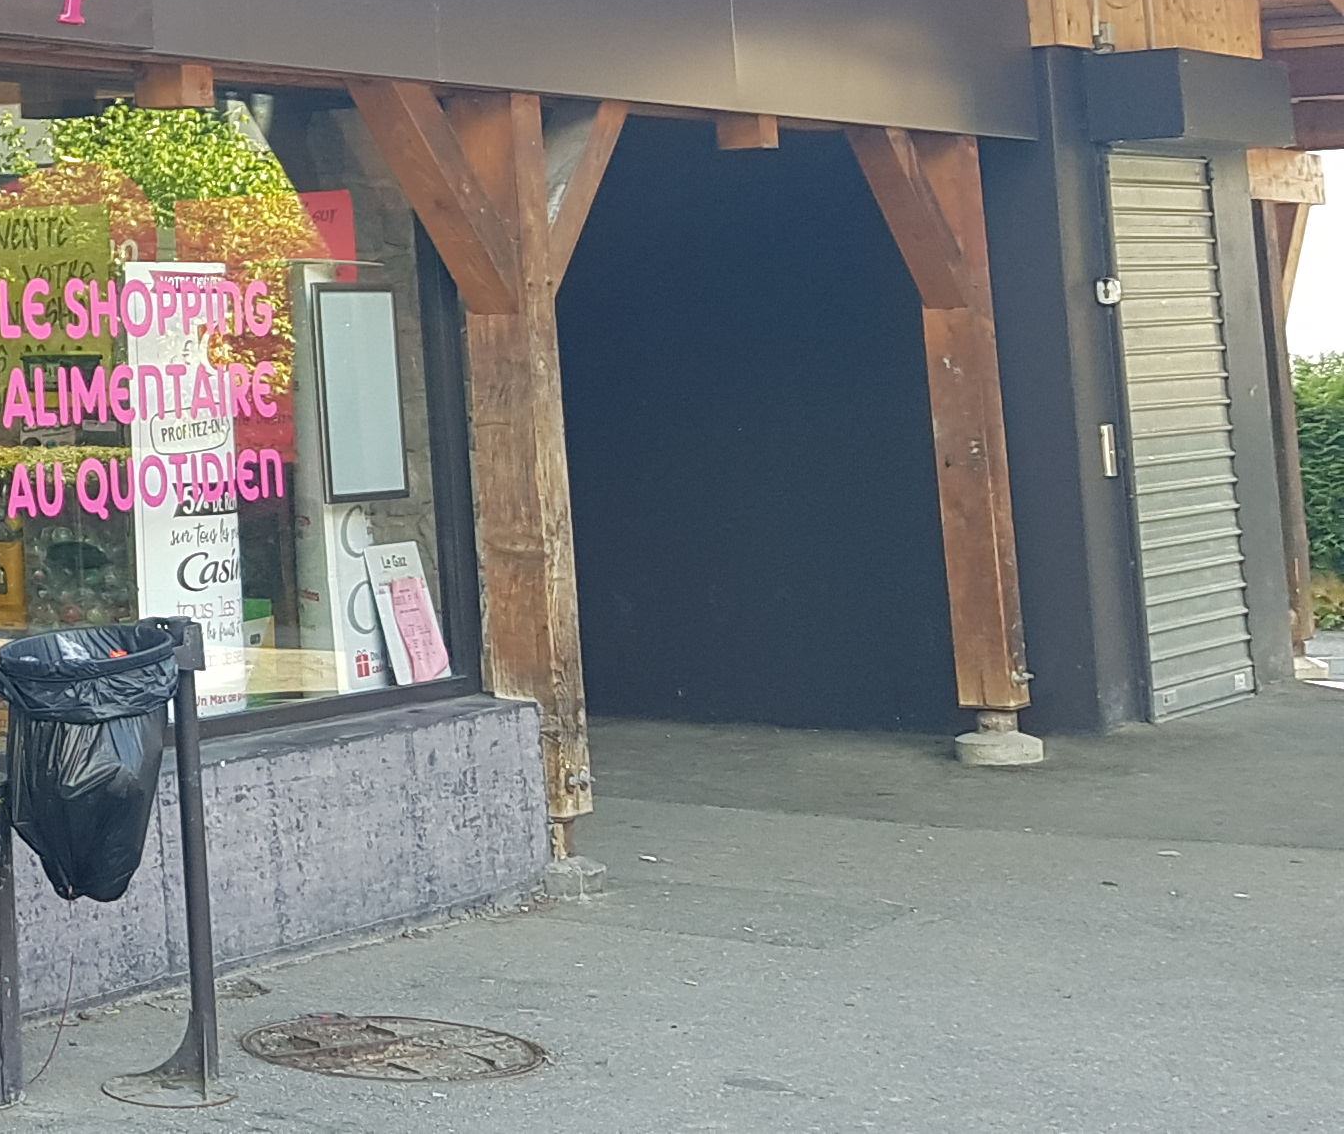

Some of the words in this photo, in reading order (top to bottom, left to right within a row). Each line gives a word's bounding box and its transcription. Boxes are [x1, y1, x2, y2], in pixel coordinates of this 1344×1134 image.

[63, 277, 273, 340] SHOPPING
[2, 361, 278, 429] ALIMENTAIRE
[7, 462, 65, 520] AU
[75, 448, 284, 520] QUOTIDIEN
